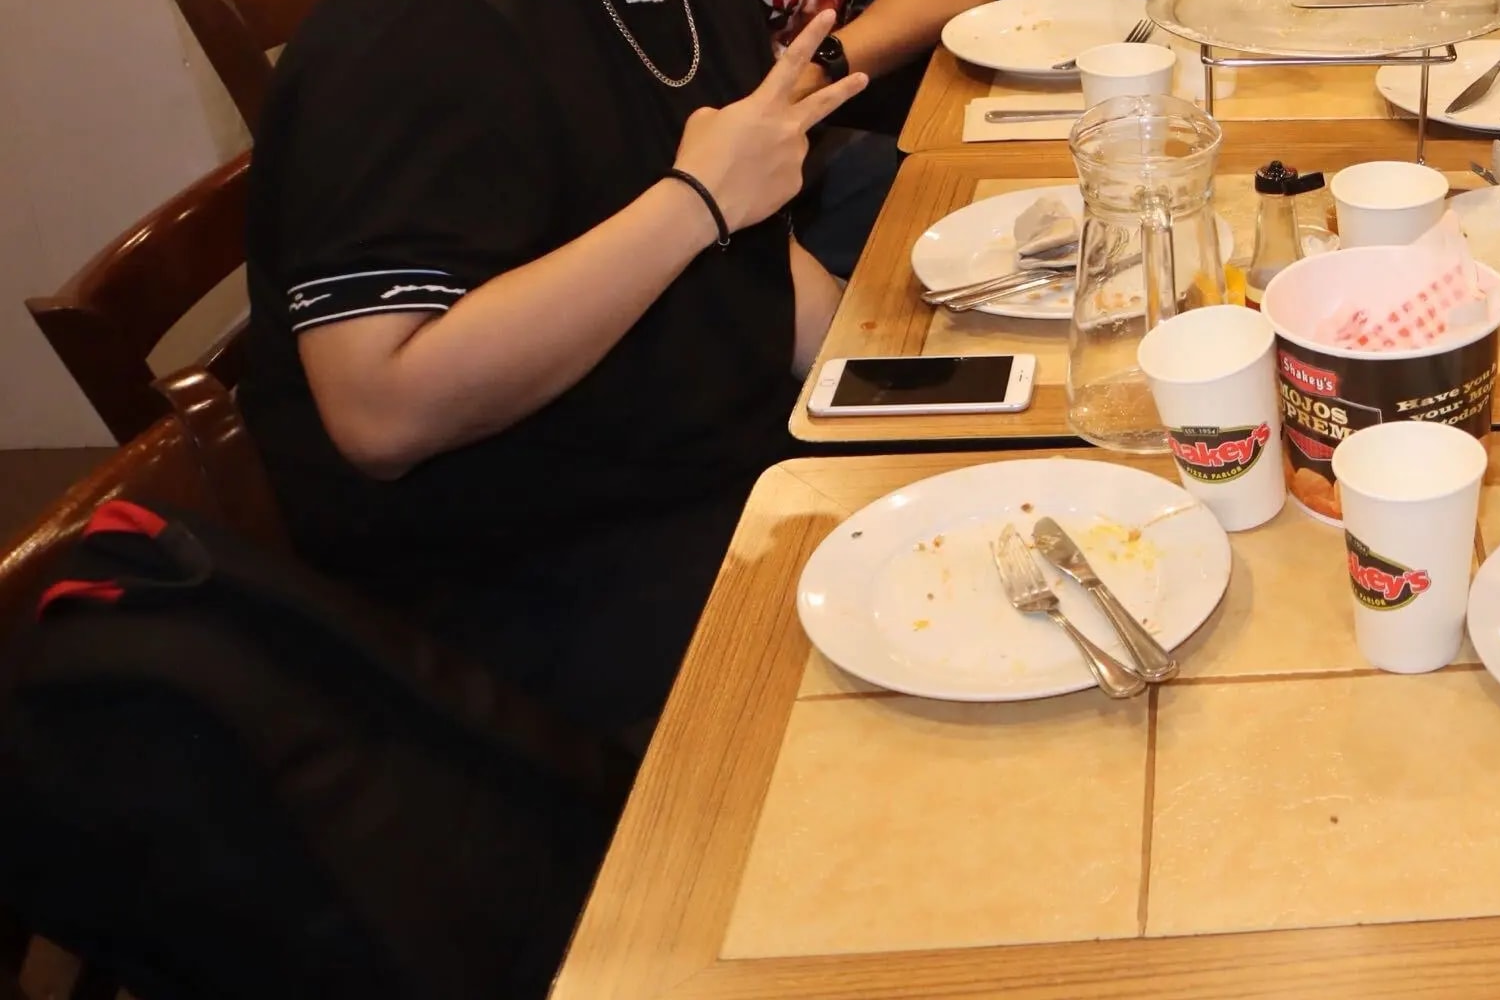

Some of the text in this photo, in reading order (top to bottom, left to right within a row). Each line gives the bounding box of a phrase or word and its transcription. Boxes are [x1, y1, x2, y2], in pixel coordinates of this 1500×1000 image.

[1283, 357, 1334, 392] Shakey's
[1397, 370, 1491, 413] Have you
[1409, 400, 1464, 423] your
[1199, 427, 1217, 435] 1954
[1186, 465, 1243, 480] PIZZA PARLOR
